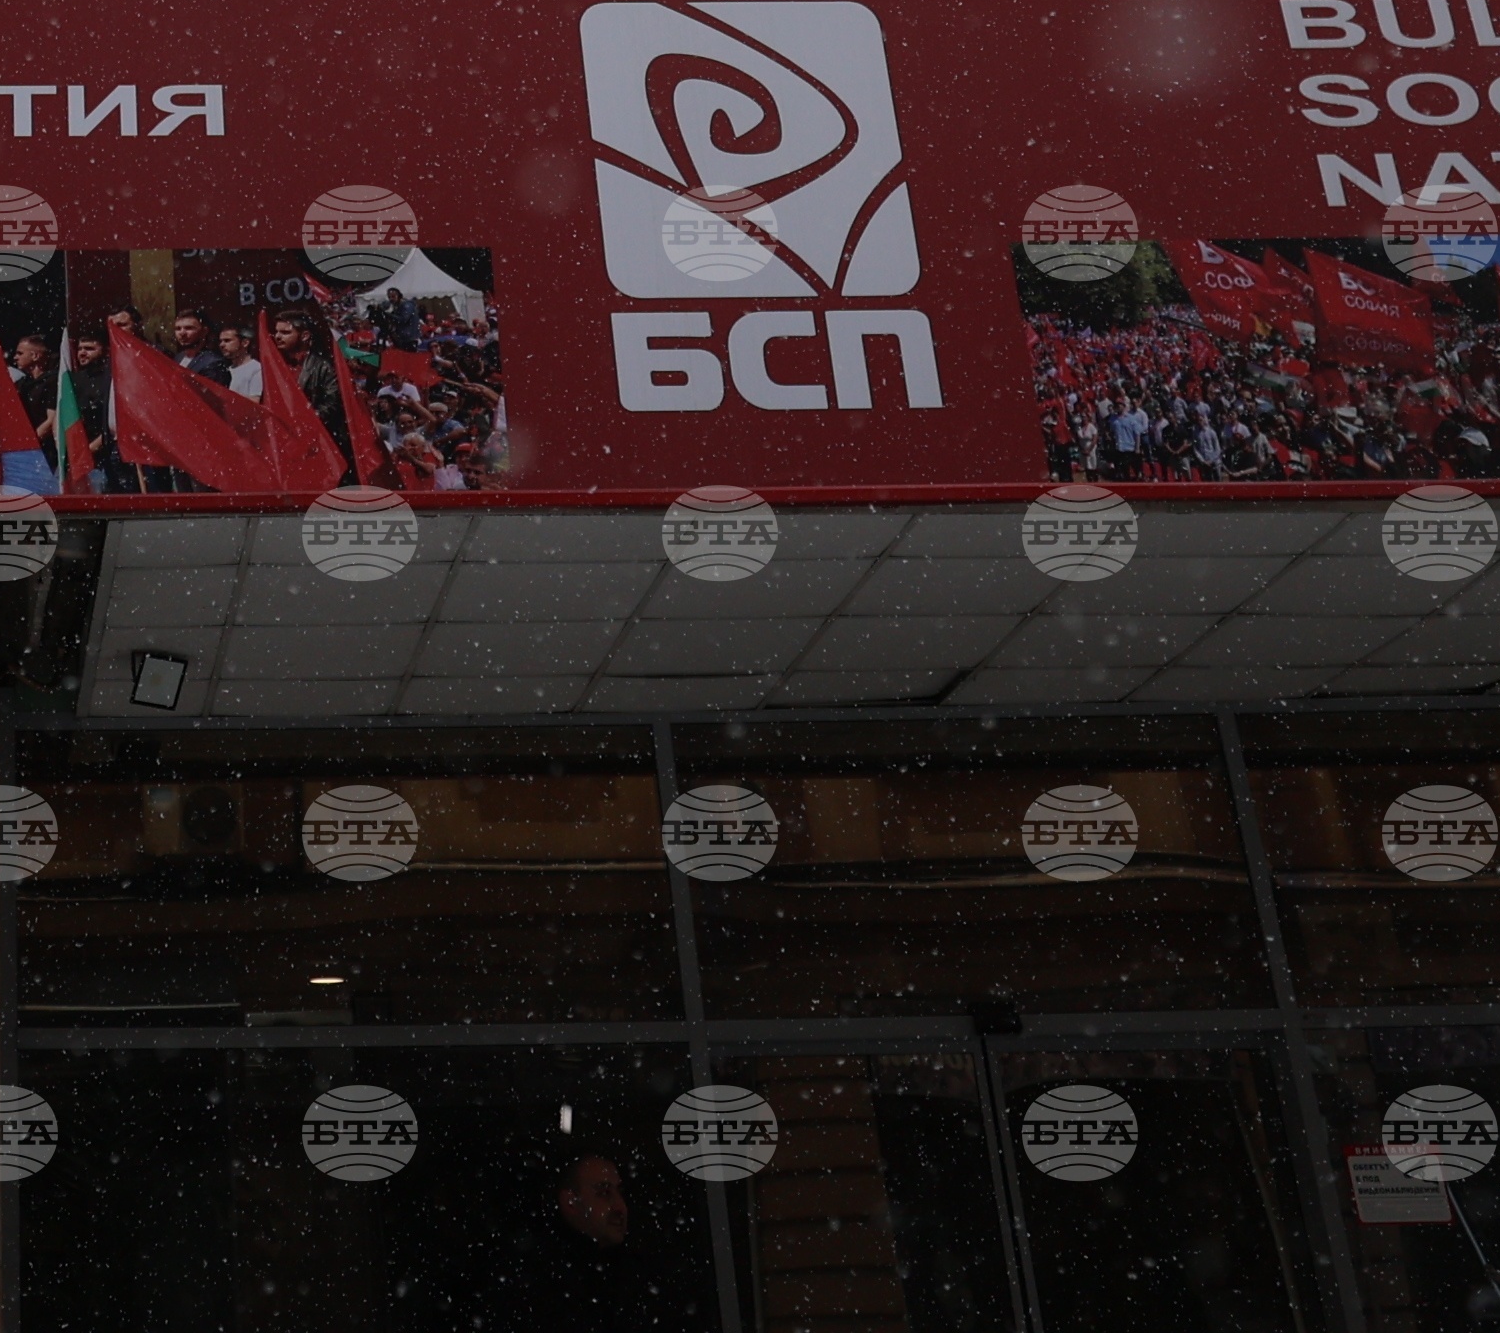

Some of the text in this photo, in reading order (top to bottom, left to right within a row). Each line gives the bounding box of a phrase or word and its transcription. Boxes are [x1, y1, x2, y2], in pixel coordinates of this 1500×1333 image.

[1204, 270, 1255, 289] СОФ
[1344, 294, 1401, 318] СОФИЯ
[1344, 334, 1406, 354] СОФИЯ
[610, 310, 945, 412] БСП
